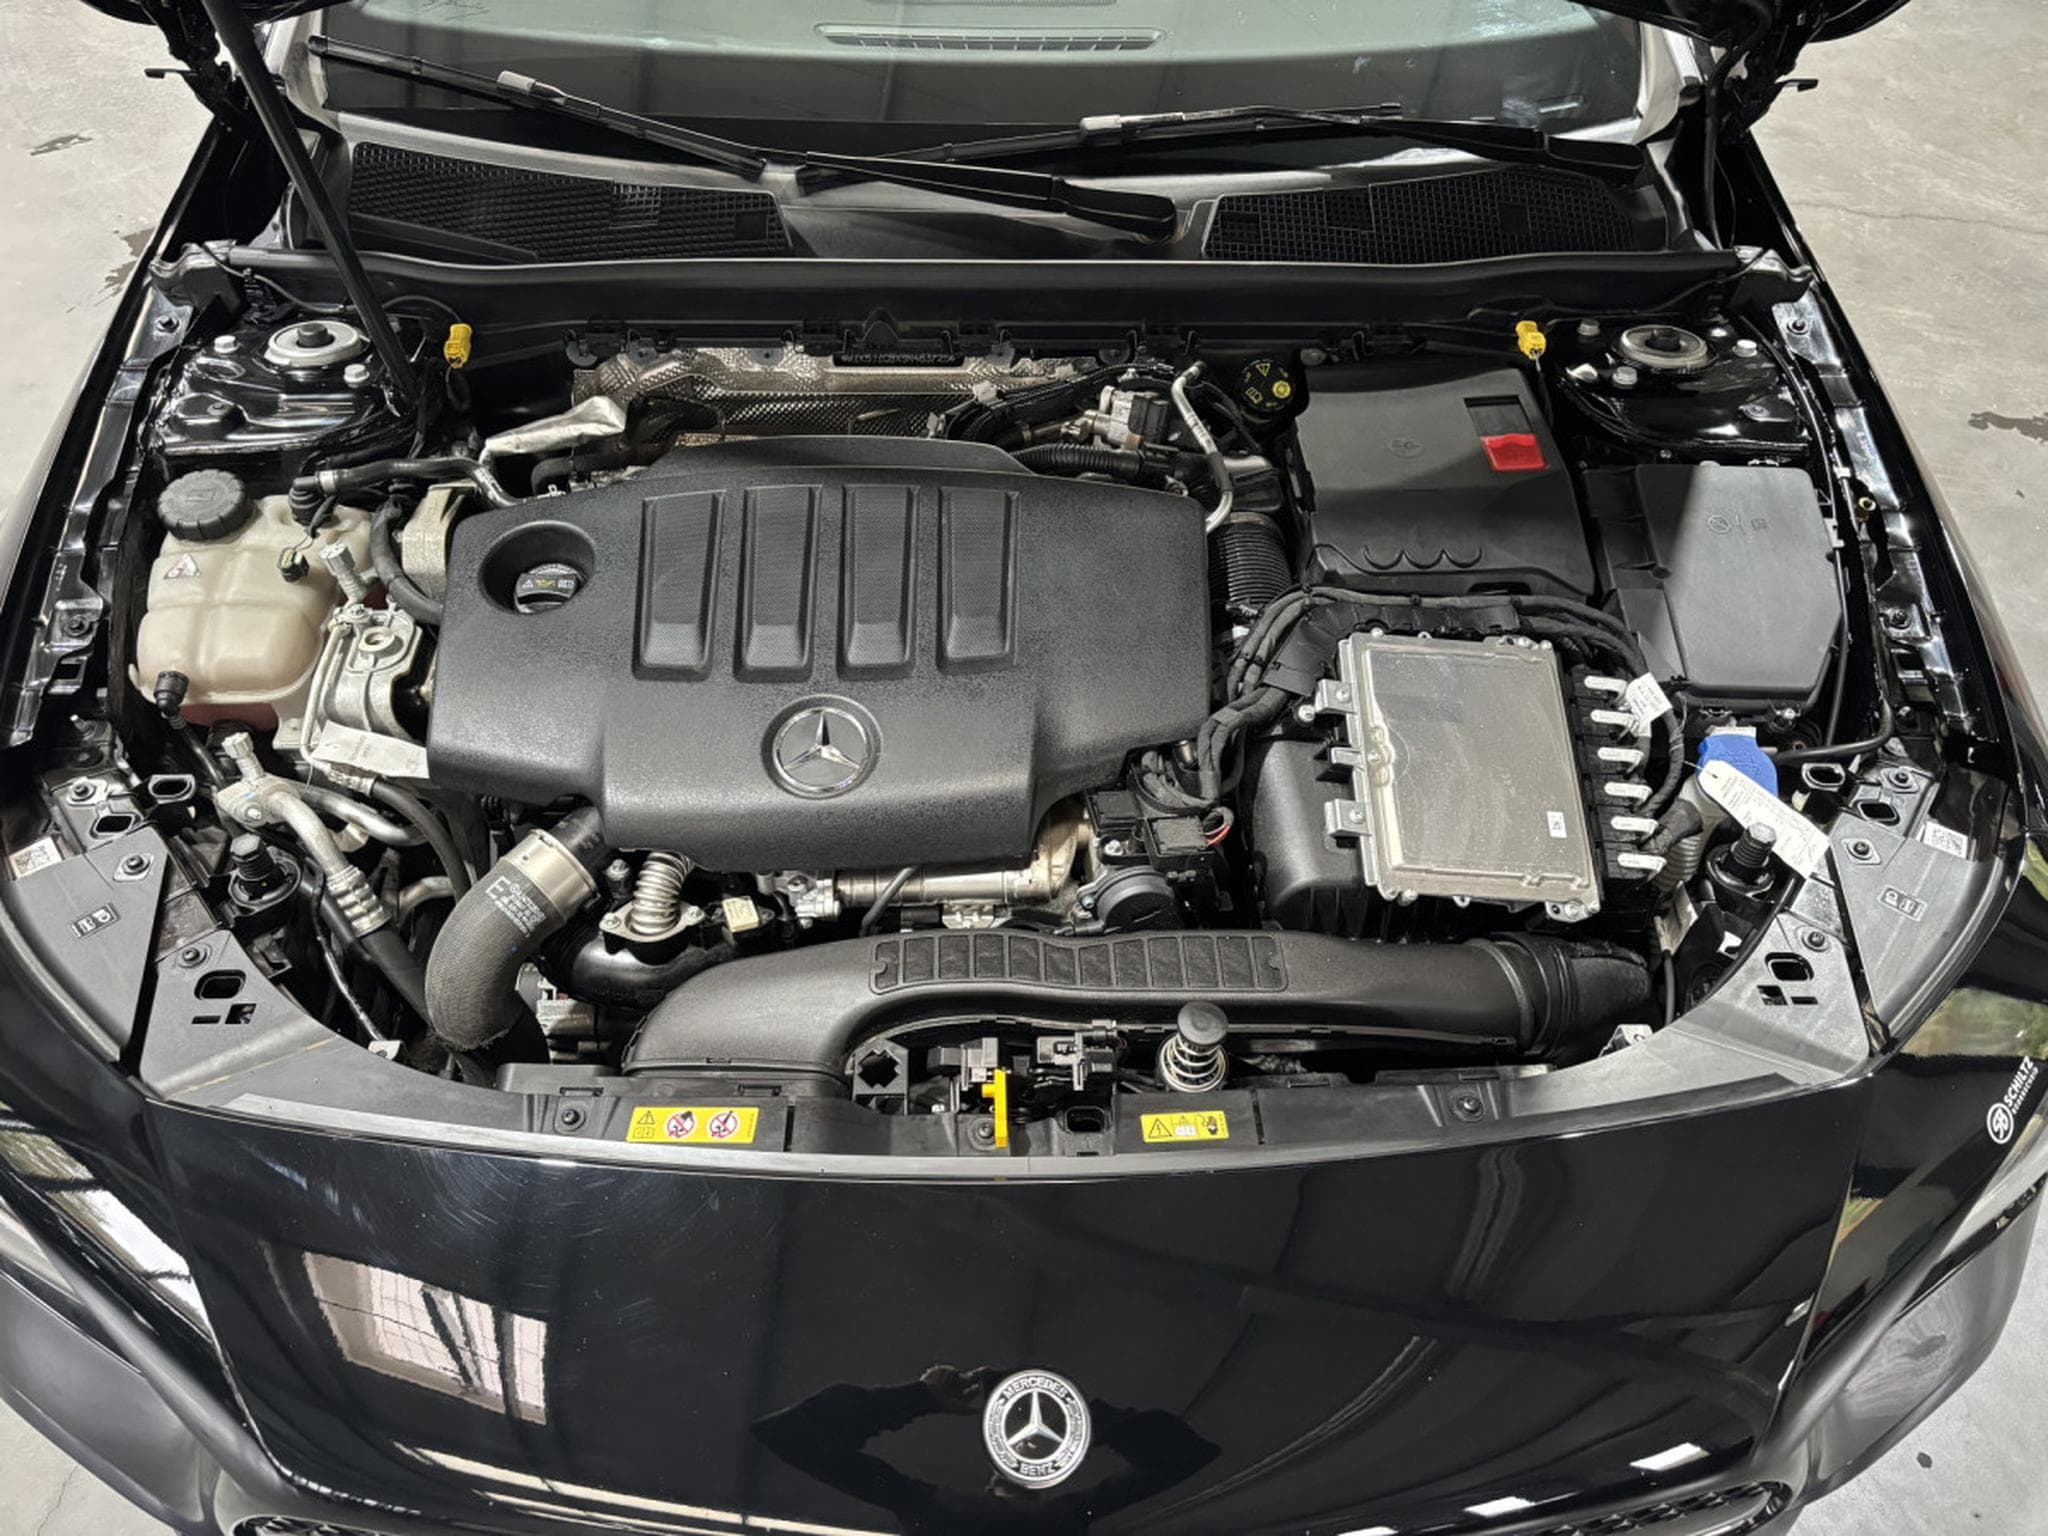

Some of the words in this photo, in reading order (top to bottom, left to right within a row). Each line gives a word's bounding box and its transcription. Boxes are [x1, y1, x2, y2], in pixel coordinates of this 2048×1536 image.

[2003, 1055, 2034, 1107] SCHILTZ
[1002, 1376, 1068, 1398] MERCEDES
[1019, 1461, 1056, 1477] BENZ
